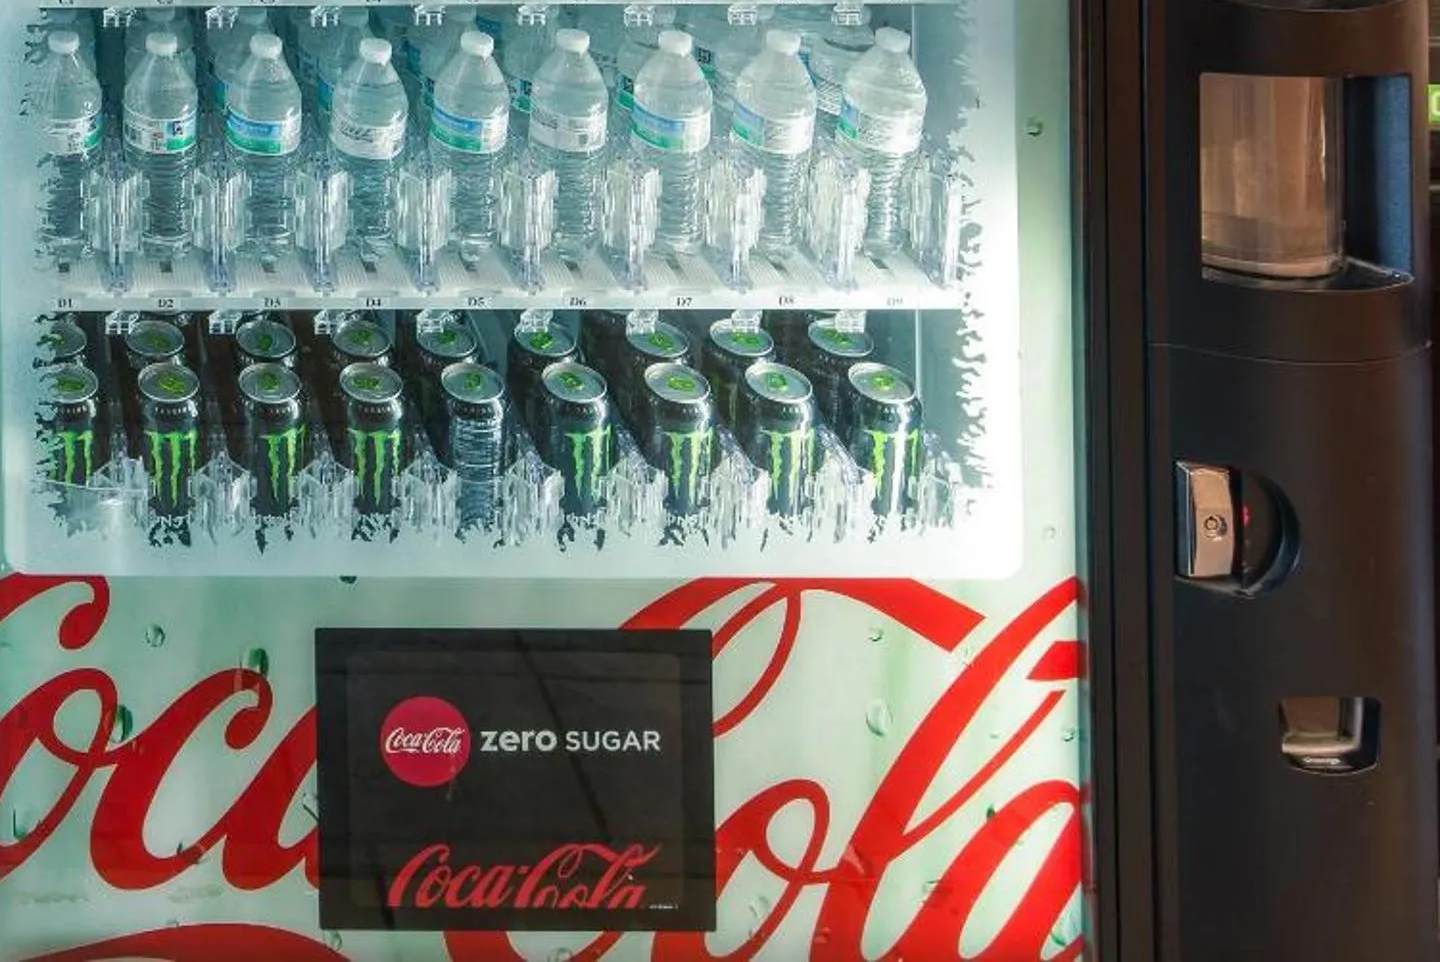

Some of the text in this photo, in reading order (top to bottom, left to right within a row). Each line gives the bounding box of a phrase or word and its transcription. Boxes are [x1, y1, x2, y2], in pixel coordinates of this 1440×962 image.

[58, 298, 72, 308] D1
[158, 299, 174, 308] D2
[366, 298, 381, 307] D4
[468, 297, 484, 307] D5
[677, 296, 692, 306] D7
[385, 726, 660, 755] Coca-Cola zero SUGAR
